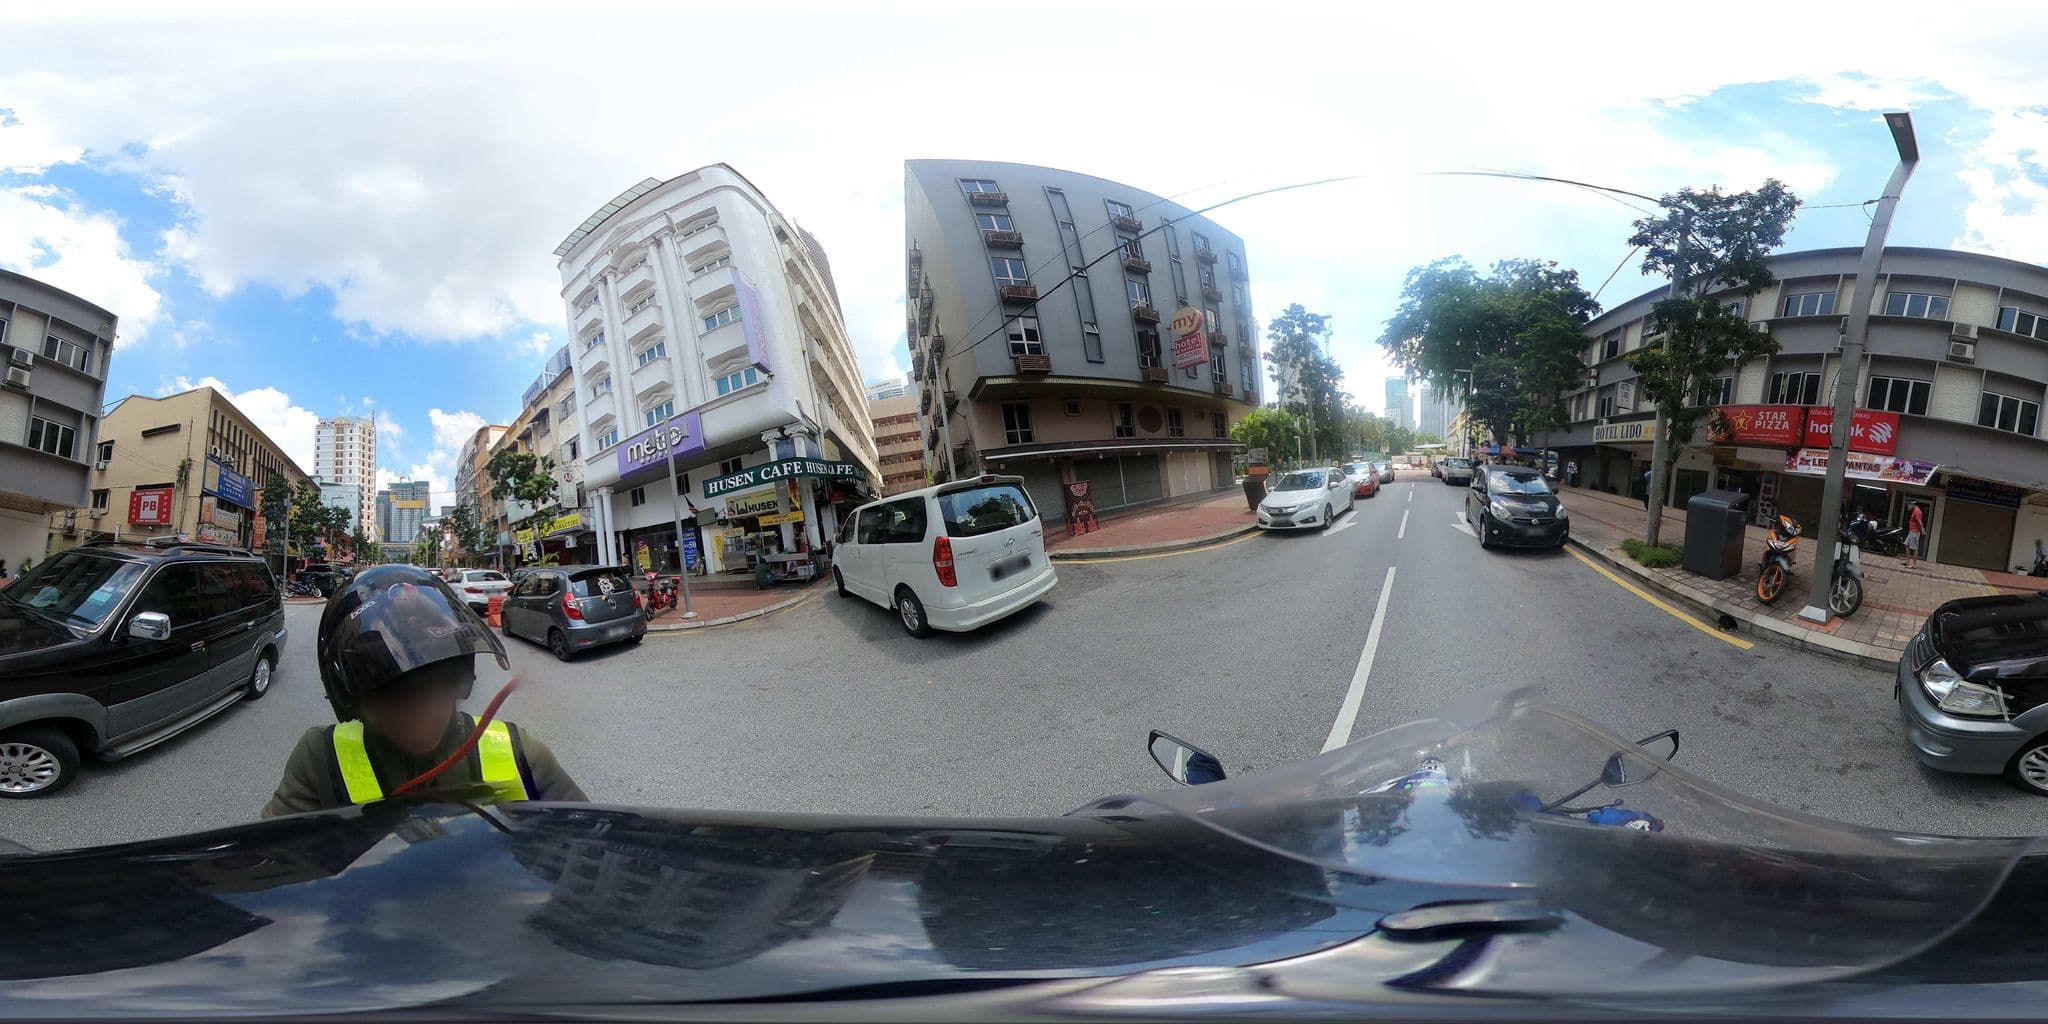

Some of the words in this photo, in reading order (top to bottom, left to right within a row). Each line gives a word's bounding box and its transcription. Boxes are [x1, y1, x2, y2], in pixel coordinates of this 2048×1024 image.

[1173, 313, 1196, 329] my
[1174, 334, 1201, 349] hotel
[1758, 411, 1787, 421] STAR
[1595, 425, 1617, 440] HOTEL
[1620, 423, 1642, 439] LIDO
[1754, 419, 1790, 431] PIZZA
[708, 471, 754, 494] HUSEN
[760, 461, 803, 480] CAFE
[142, 501, 157, 511] PB
